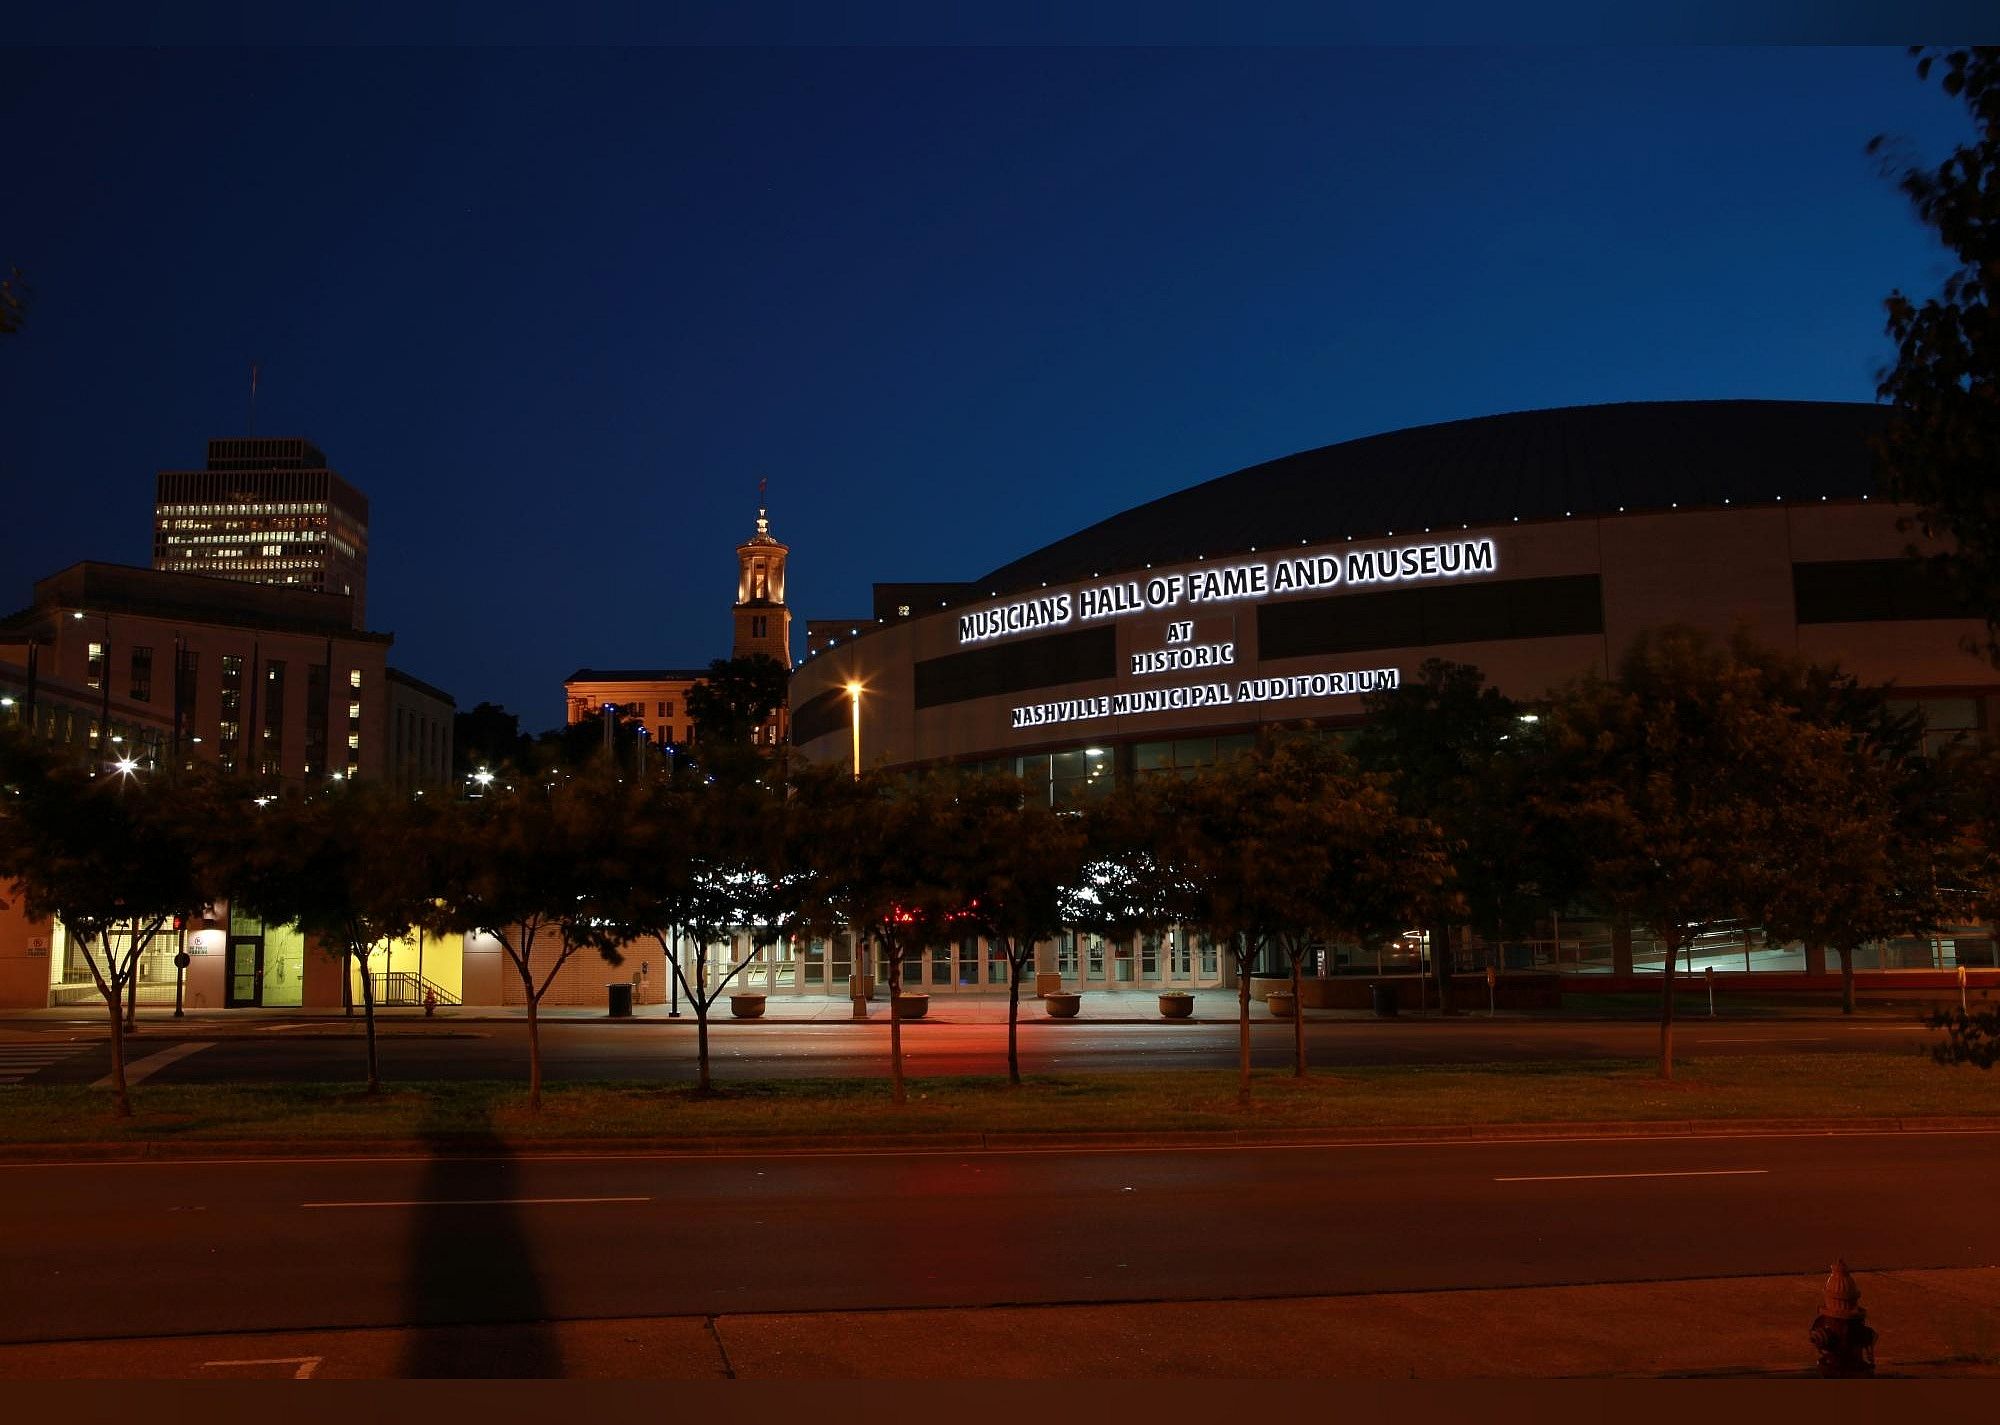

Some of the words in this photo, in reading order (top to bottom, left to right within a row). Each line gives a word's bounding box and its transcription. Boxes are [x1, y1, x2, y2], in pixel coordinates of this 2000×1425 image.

[959, 595, 1070, 642] MUSICIANS
[1080, 583, 1143, 617] HALL
[1147, 576, 1182, 607] OF
[1188, 565, 1267, 601] FAME
[1274, 557, 1339, 590] AND
[1348, 541, 1494, 582] MUSEUM
[1167, 621, 1193, 642] AT
[1131, 644, 1233, 674] HISTORIC
[1011, 697, 1108, 727] NASHVILLE
[1113, 684, 1231, 714] MUNICIPAL
[1237, 669, 1398, 702] AUDITORIUM
